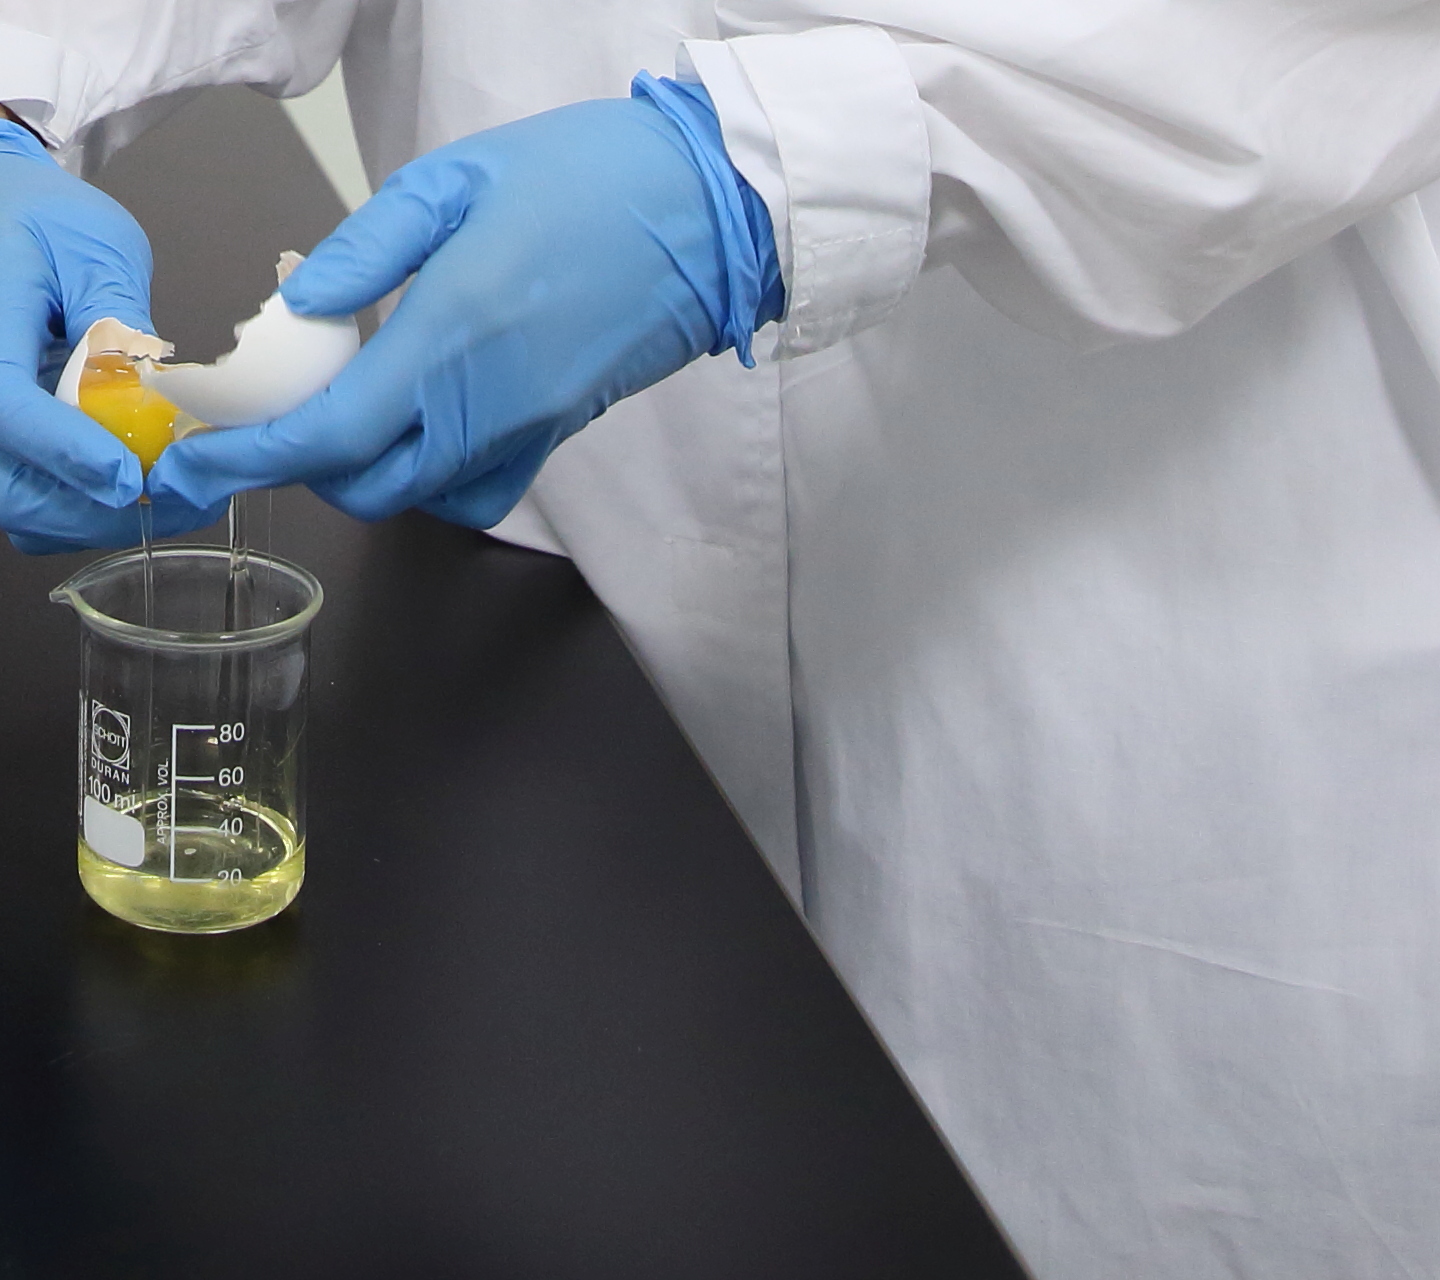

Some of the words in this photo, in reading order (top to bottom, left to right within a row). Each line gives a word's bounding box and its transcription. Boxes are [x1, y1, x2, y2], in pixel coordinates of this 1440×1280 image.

[93, 723, 127, 749] SCHOTT
[219, 722, 245, 743] 80
[91, 756, 130, 785] DURAN
[218, 766, 245, 787] 60
[88, 775, 111, 804] 100
[219, 816, 244, 838] 40
[217, 867, 243, 887] 20
